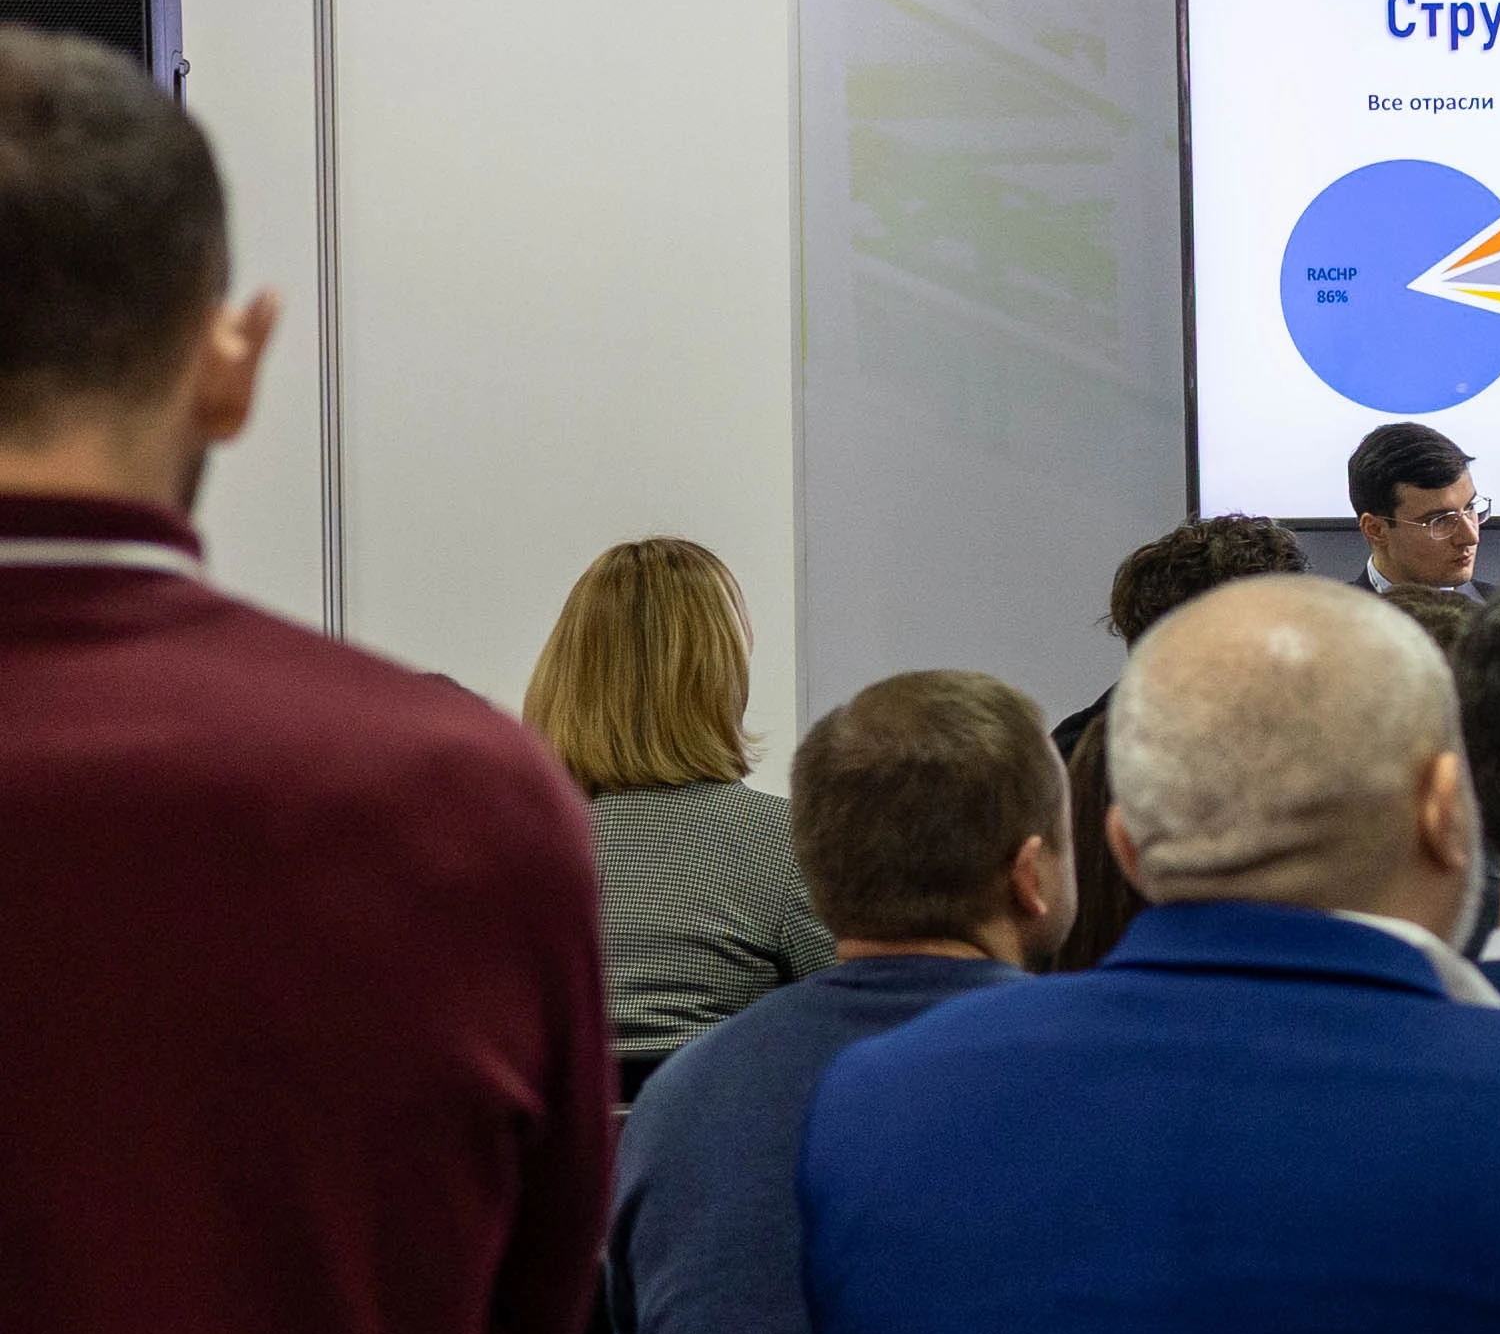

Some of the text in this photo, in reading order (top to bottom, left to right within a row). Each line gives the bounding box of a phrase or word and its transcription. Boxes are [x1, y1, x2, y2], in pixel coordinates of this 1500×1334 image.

[1367, 94, 1495, 115] Все отрасли
[1306, 267, 1358, 283] RACHP
[1316, 290, 1349, 304] 86%
